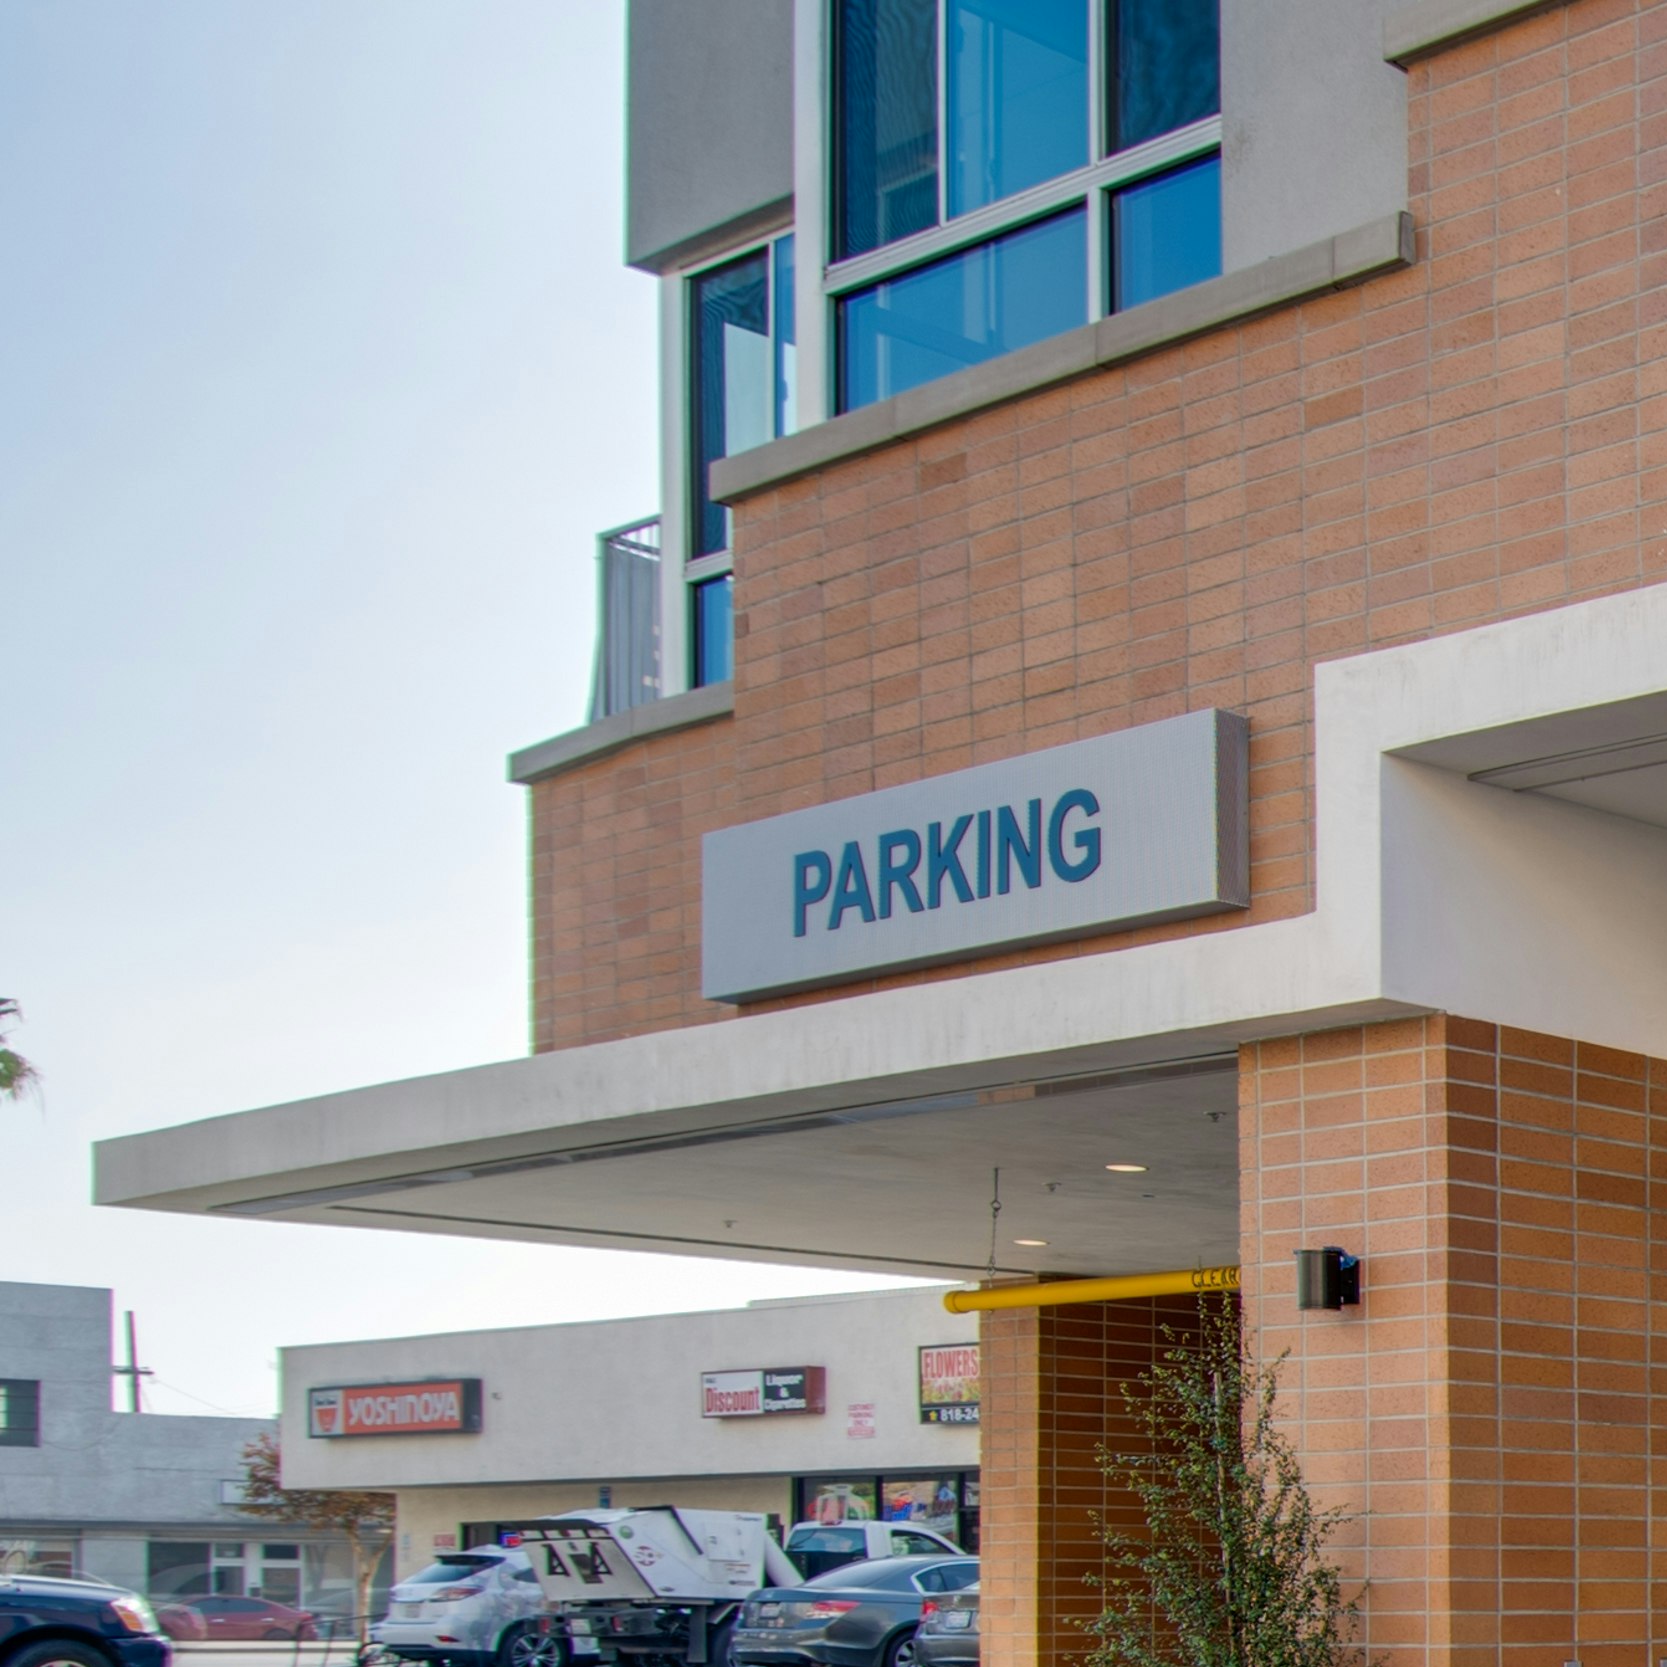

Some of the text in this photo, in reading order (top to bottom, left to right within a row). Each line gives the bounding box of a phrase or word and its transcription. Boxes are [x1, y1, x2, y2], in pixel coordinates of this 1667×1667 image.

[793, 788, 1101, 938] PARKING
[924, 1349, 979, 1378] FLOWERS
[766, 1374, 804, 1387] Liquor
[349, 1391, 460, 1426] YOSHINOYA
[705, 1386, 760, 1412] Discount
